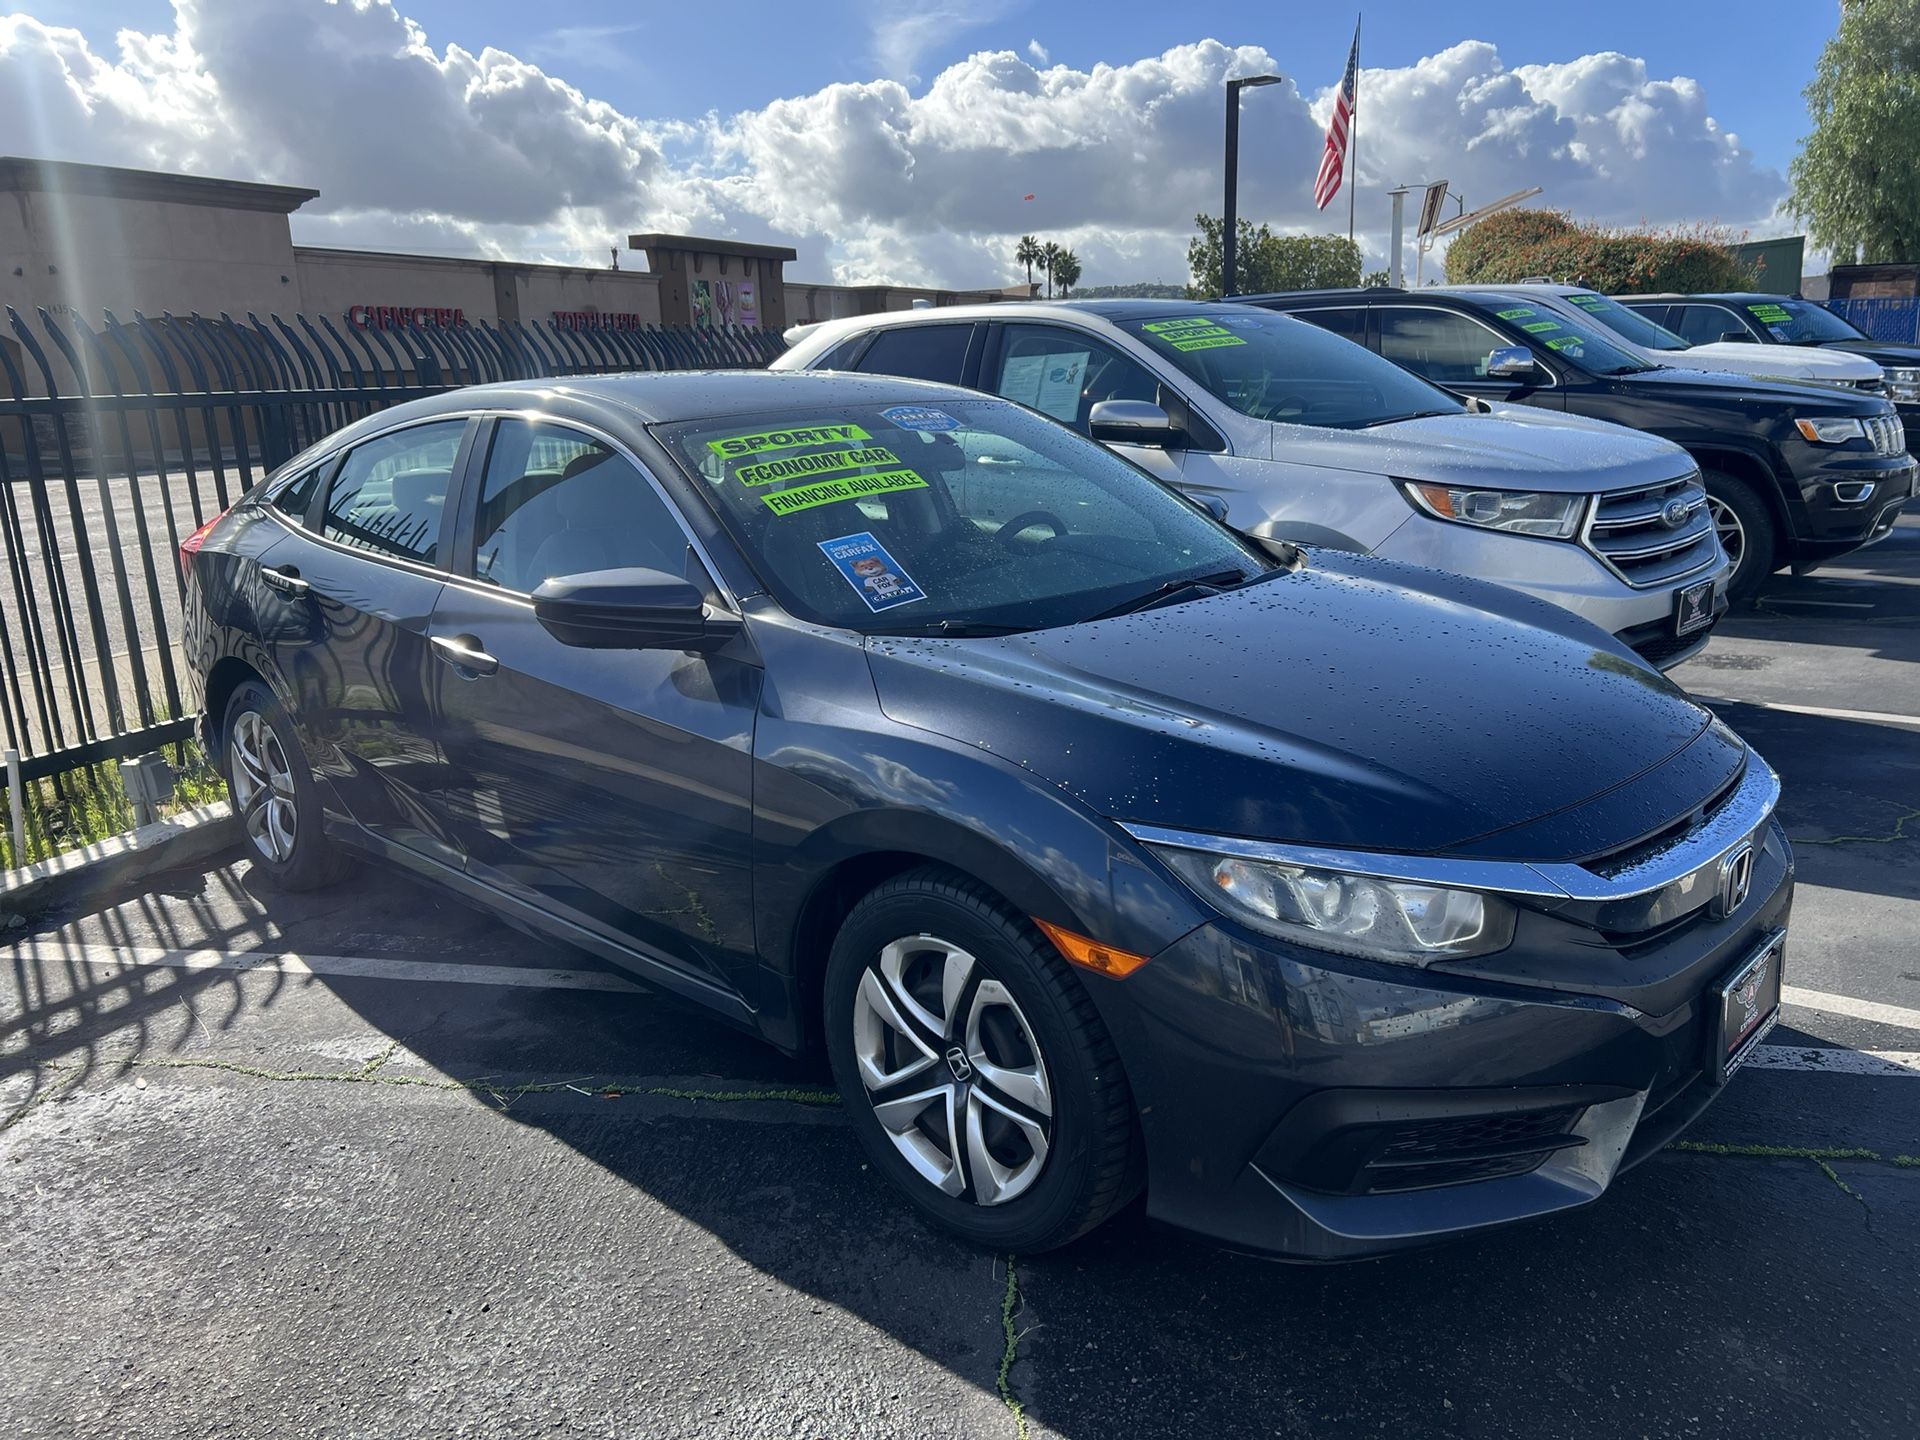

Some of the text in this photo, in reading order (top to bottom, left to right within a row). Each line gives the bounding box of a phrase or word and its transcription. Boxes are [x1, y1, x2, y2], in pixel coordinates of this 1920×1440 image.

[1164, 327, 1225, 340] SPORTY
[721, 427, 852, 454] SPORTY
[740, 448, 893, 484] ECONOMY CAR
[769, 472, 923, 511] FINANCING AVAILABLE
[834, 544, 878, 560] CARFAX
[872, 576, 889, 585] CAR
[877, 582, 893, 590] FOX
[872, 586, 915, 602] CARFAX
